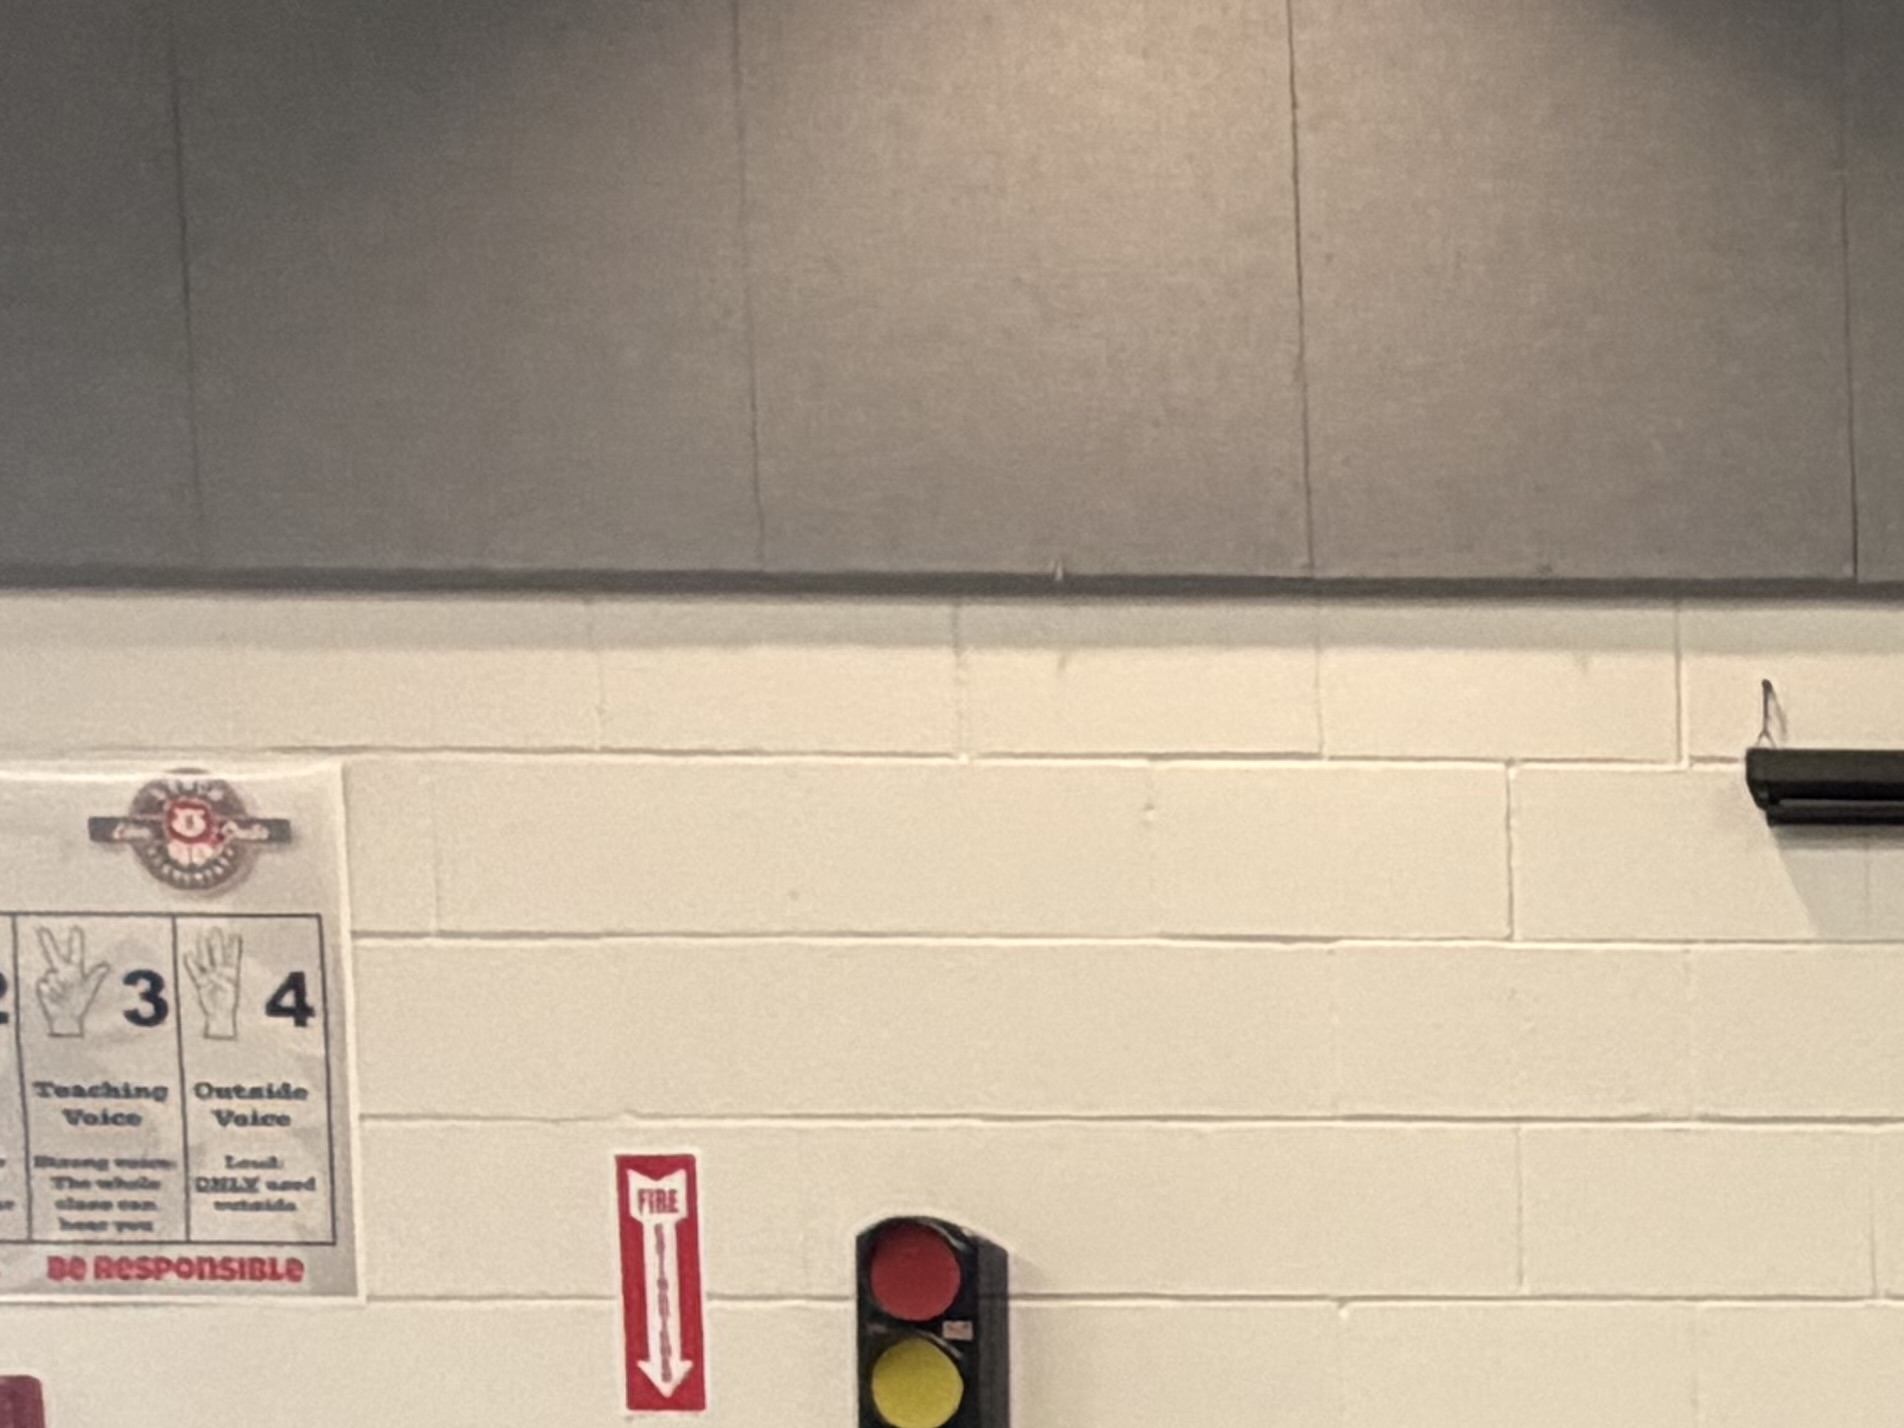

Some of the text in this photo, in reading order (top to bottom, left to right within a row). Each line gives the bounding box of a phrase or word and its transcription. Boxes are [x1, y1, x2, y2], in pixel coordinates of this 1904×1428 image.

[123, 969, 169, 1028] 3
[265, 970, 315, 1028] 4
[32, 1081, 168, 1102] Teaching
[194, 1081, 309, 1100] Outside
[62, 1108, 142, 1126] Voice
[211, 1108, 291, 1127] Voice
[637, 1188, 679, 1214] FIRE
